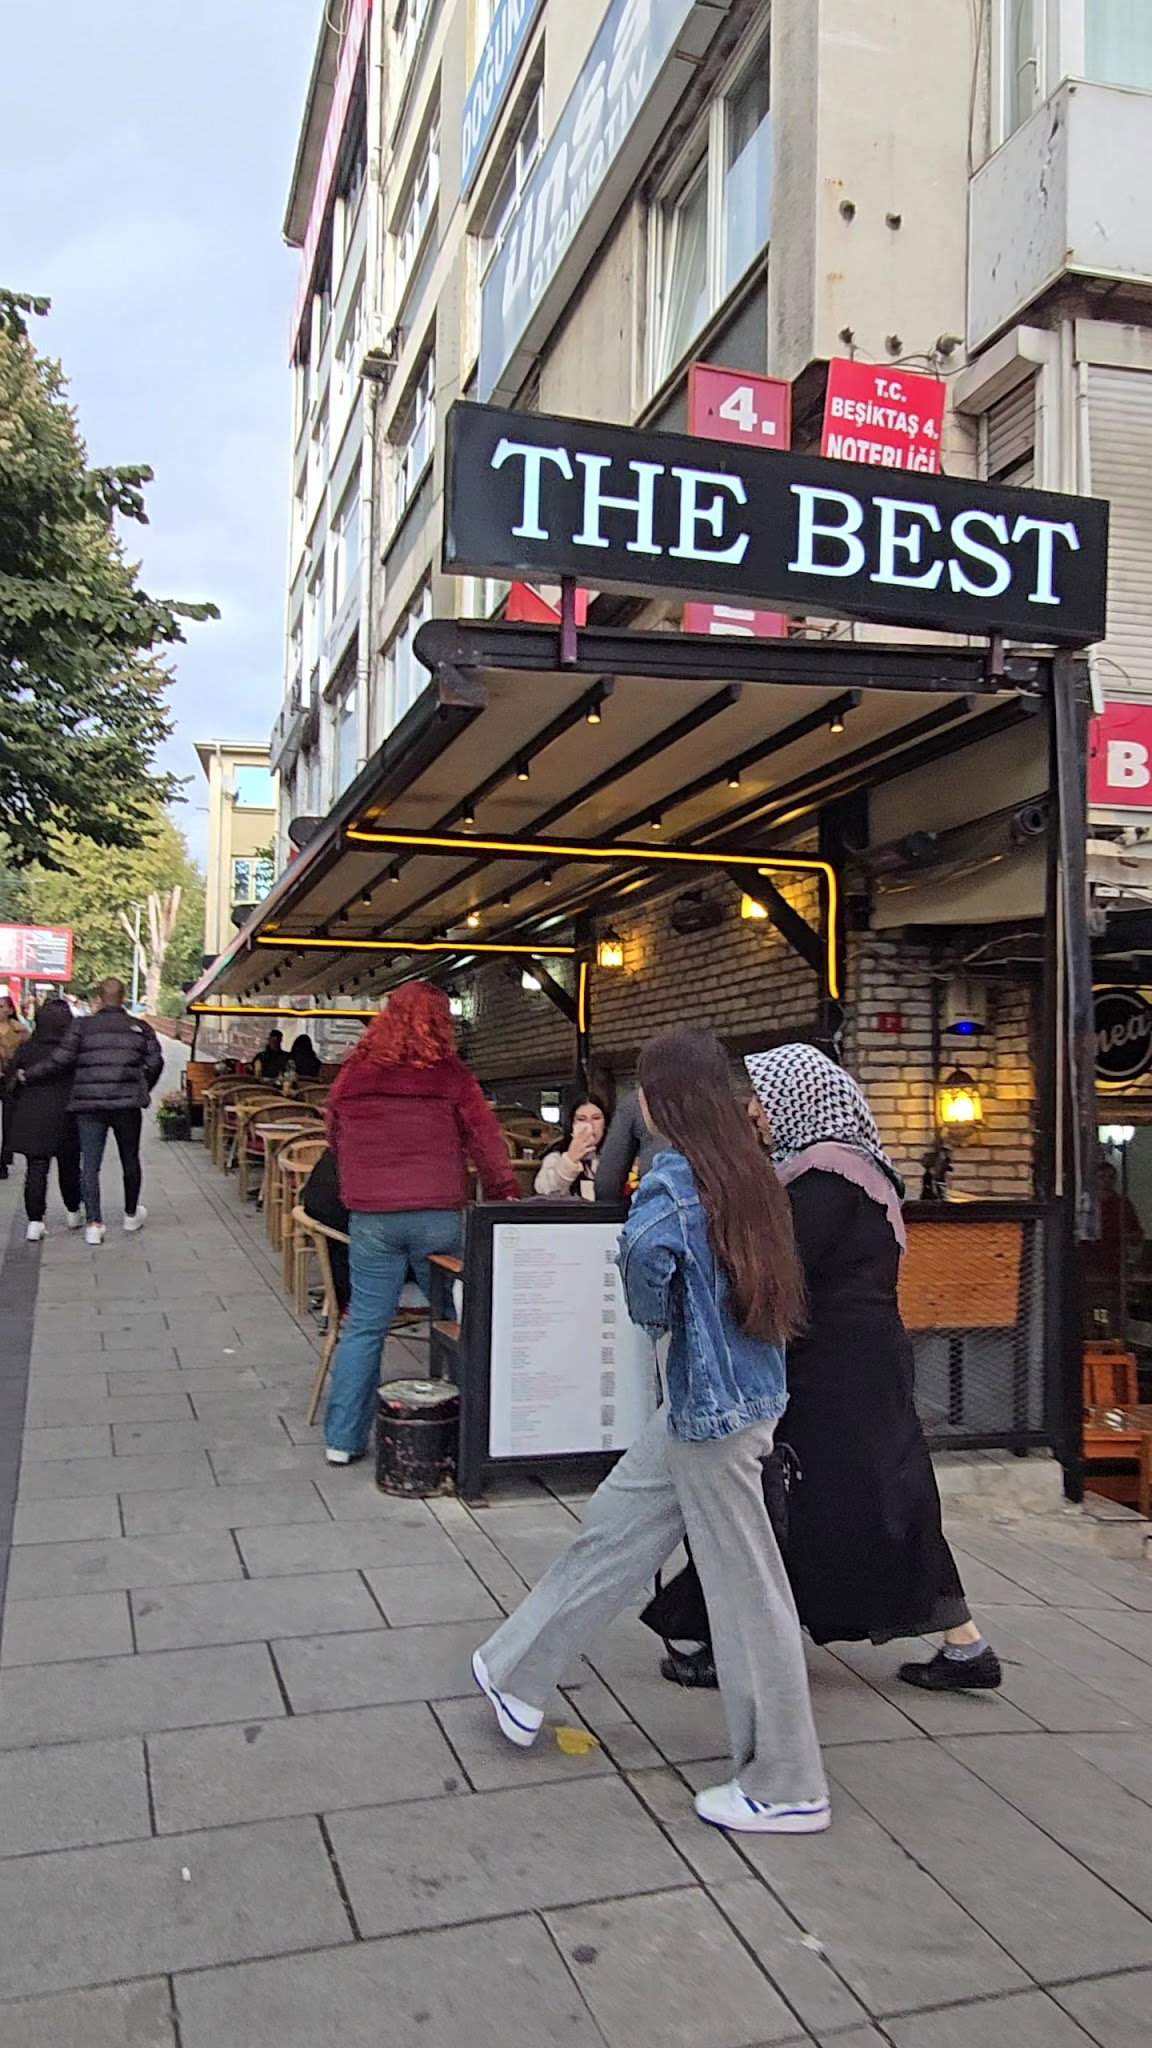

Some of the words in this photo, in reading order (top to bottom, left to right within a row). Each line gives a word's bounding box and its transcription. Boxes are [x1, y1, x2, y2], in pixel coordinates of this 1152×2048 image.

[718, 386, 776, 436] 4.
[874, 378, 908, 402] T.C.
[831, 396, 919, 440] BEŞİKTAŞ
[922, 420, 939, 440] 4.
[490, 438, 750, 565] THE
[788, 483, 1081, 606] BEST
